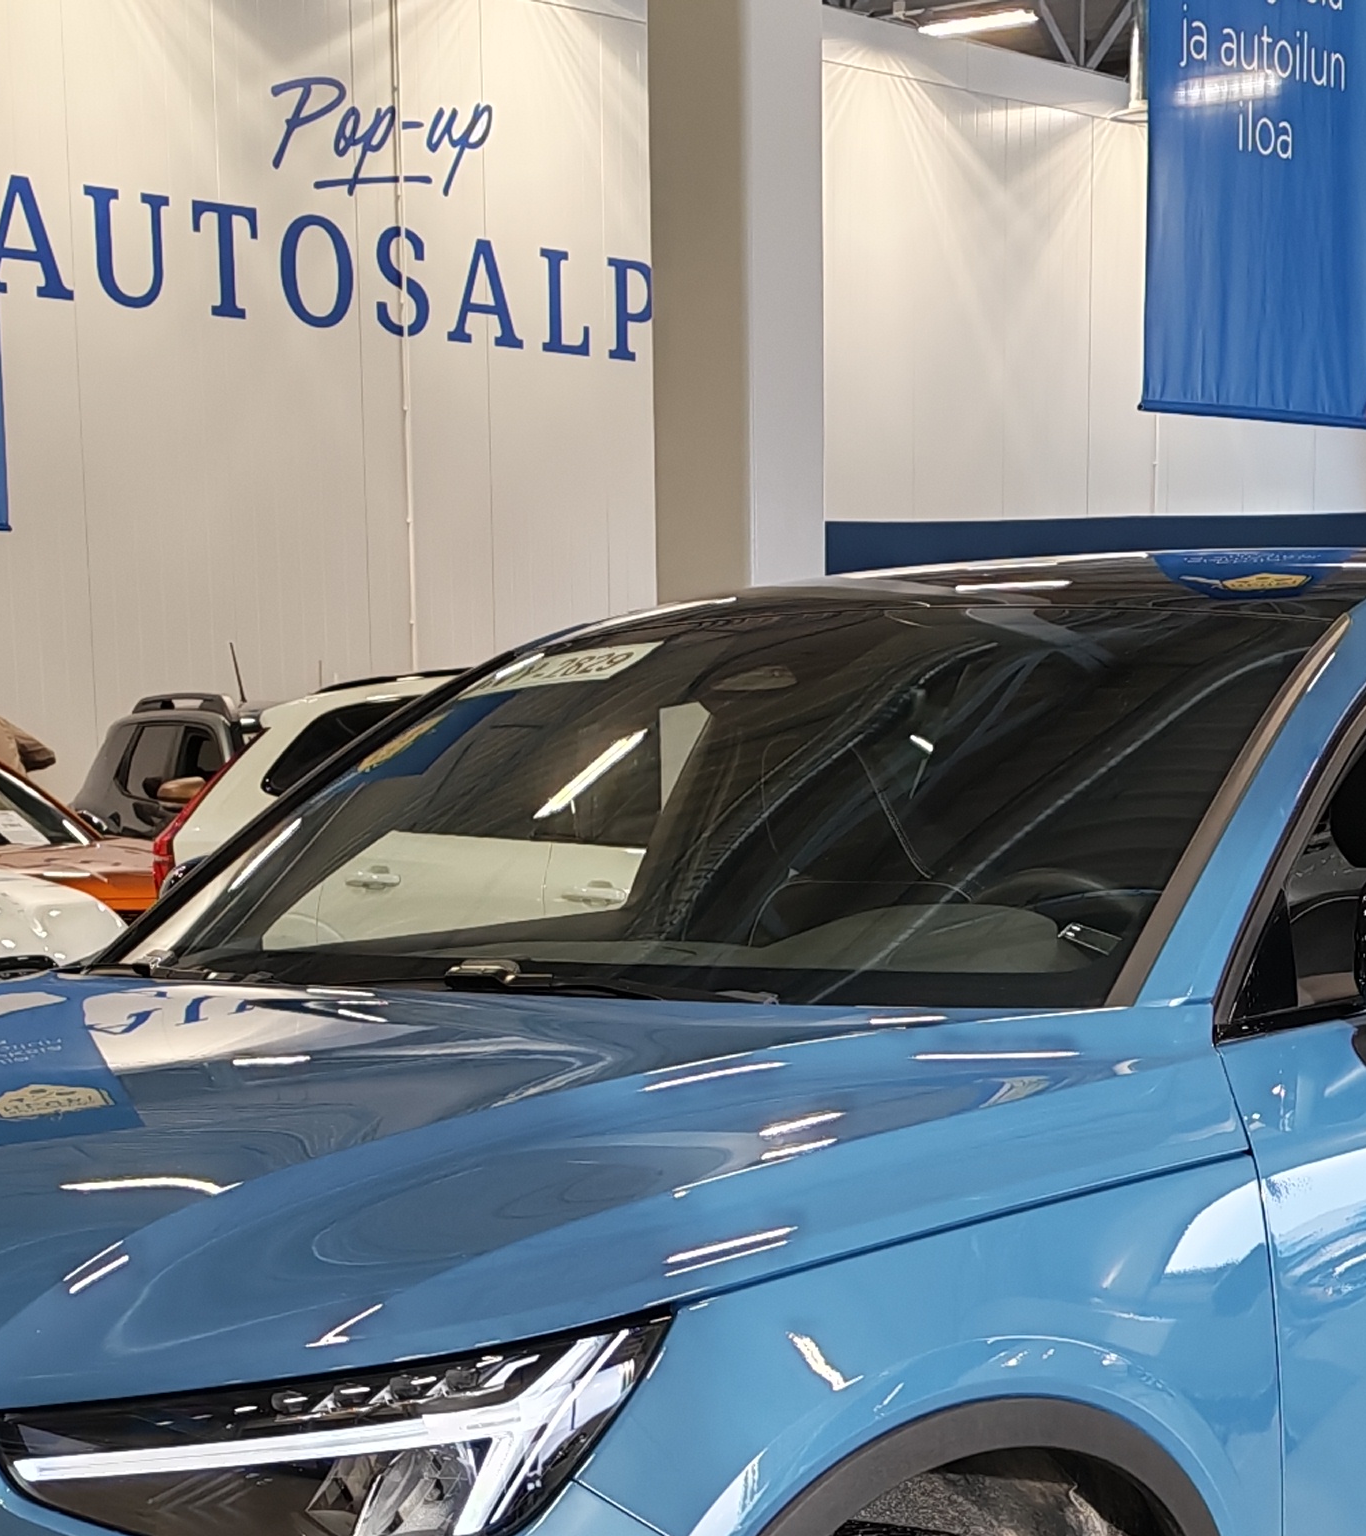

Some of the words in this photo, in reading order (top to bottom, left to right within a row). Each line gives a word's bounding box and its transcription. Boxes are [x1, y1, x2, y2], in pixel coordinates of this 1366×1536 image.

[1180, 4, 1208, 68] ja
[1220, 25, 1346, 92] autoilun
[271, 76, 493, 196] Pop-up
[1237, 100, 1293, 160] iloa
